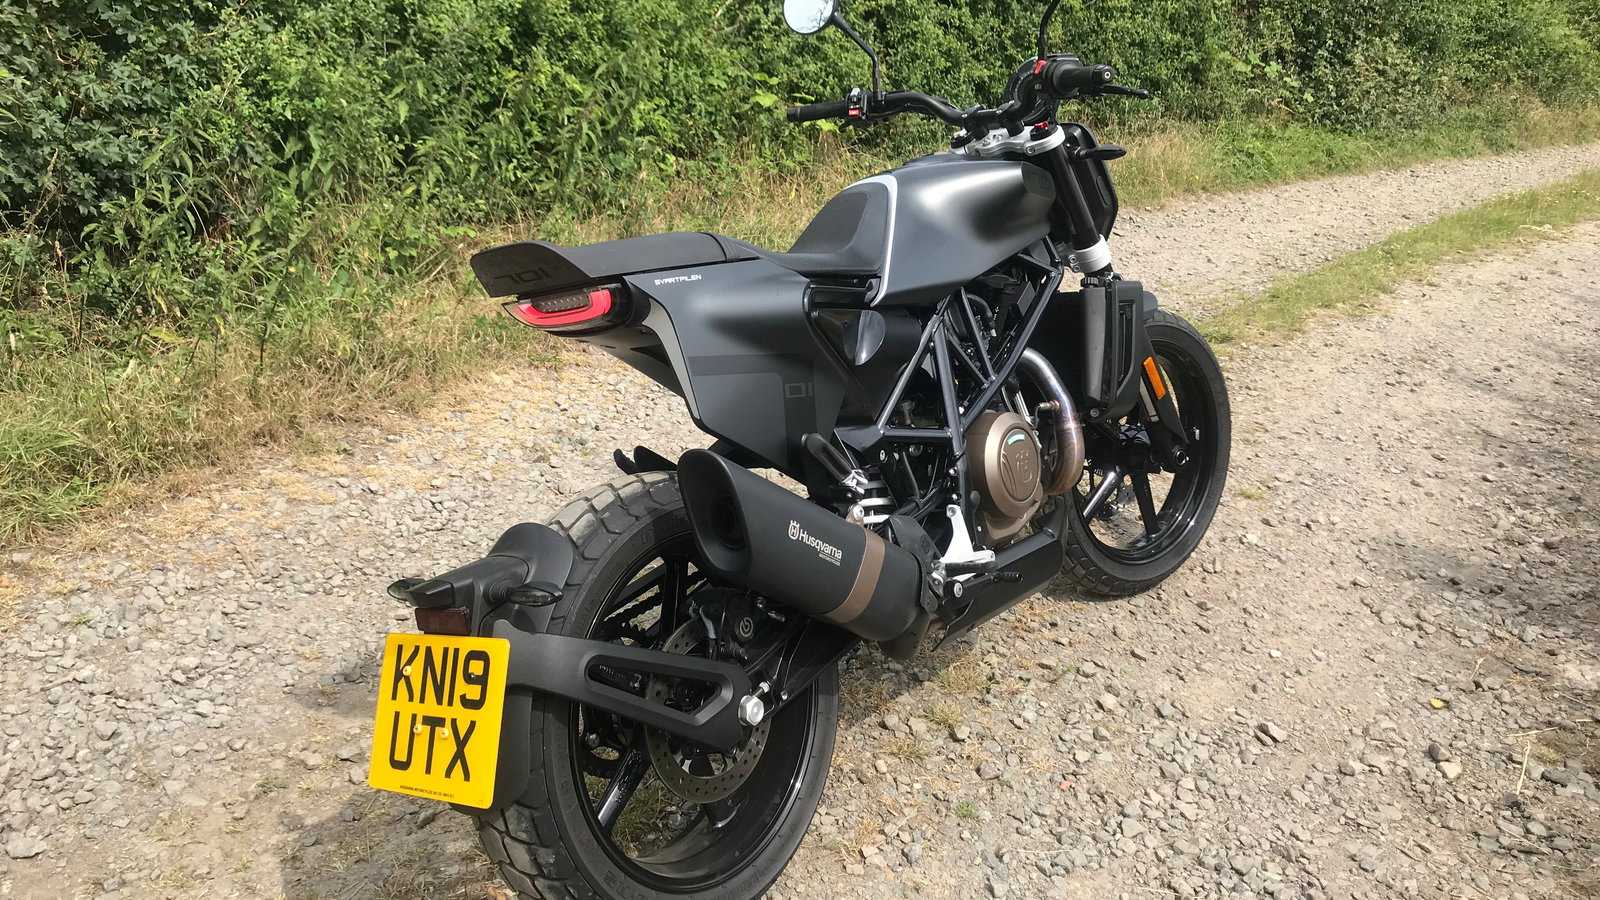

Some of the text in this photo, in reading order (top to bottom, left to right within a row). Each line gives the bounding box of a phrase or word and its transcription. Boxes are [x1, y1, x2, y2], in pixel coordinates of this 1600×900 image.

[493, 267, 552, 284] 701
[654, 274, 702, 286] SVARTPILEN
[799, 529, 842, 559] Husqvarna
[391, 644, 490, 710] KN19
[389, 711, 477, 782] UTX
